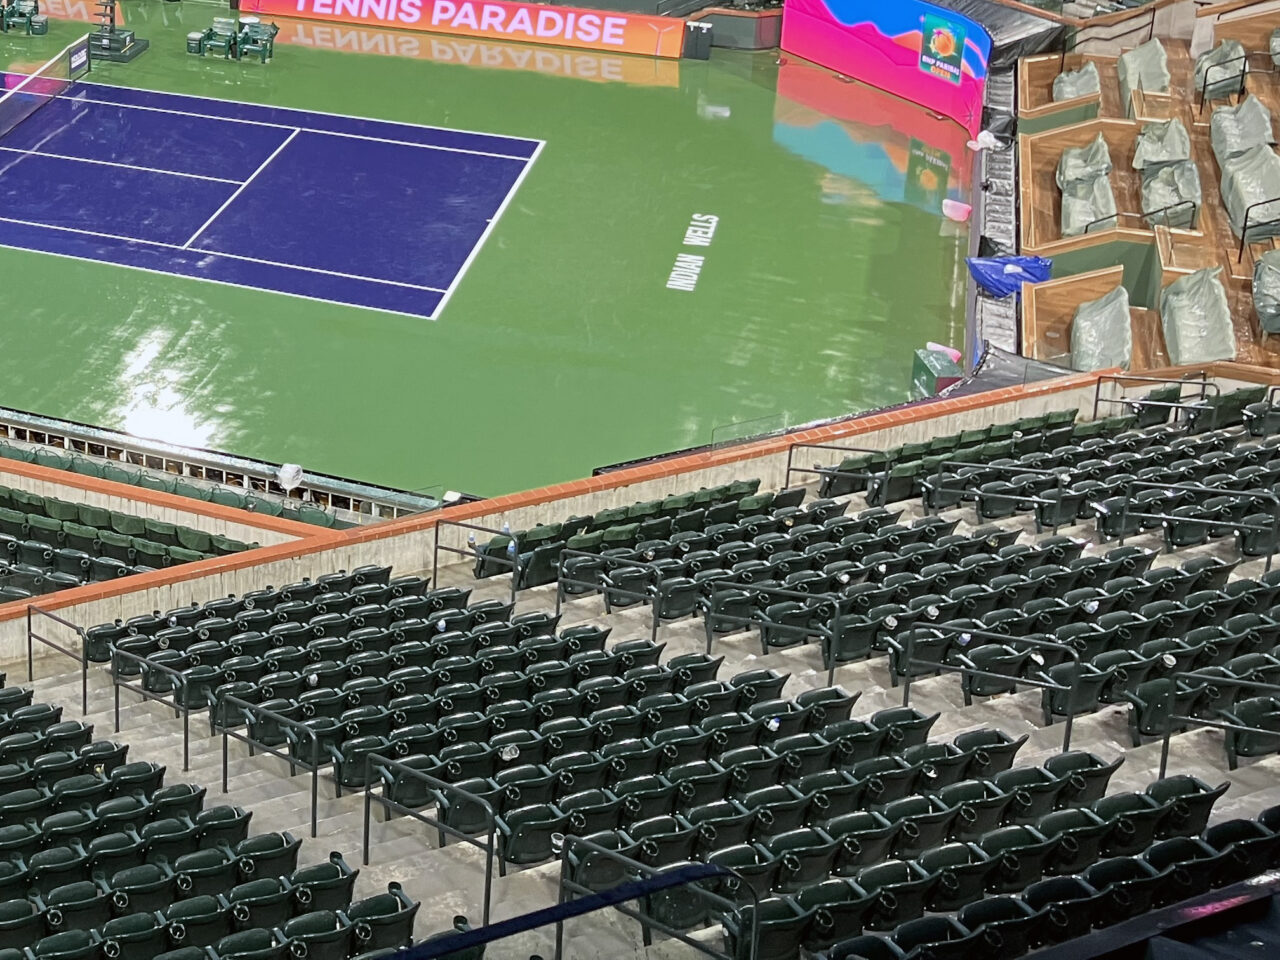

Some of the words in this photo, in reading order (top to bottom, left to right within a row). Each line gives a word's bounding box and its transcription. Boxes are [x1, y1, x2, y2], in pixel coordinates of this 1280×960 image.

[431, 0, 627, 45] PARADISE
[922, 55, 936, 65] BNP
[682, 213, 719, 246] WELLS
[666, 253, 705, 291] INDIAN
